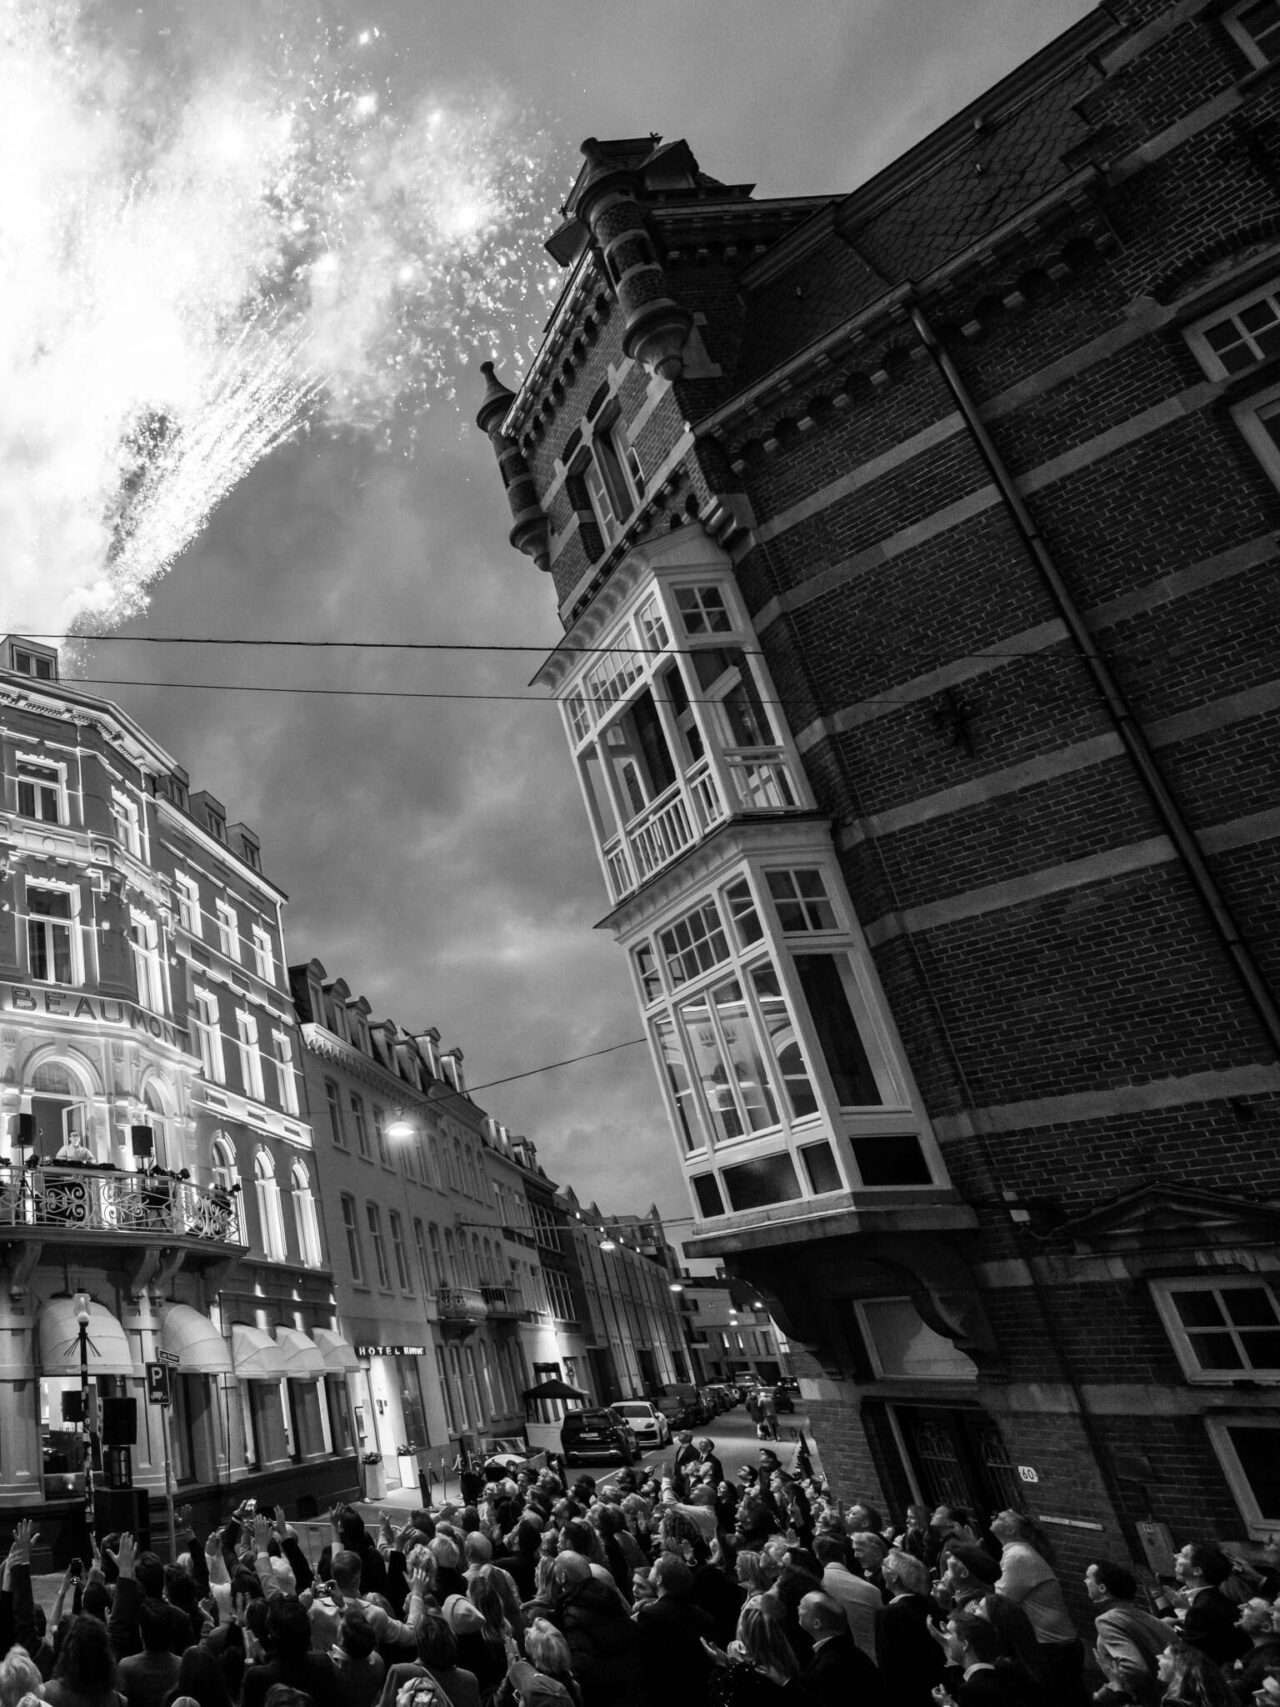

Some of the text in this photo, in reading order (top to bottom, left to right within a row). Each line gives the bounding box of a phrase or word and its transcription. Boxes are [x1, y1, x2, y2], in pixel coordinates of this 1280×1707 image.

[11, 985, 189, 1052] BEAUMONT
[359, 1346, 401, 1355] HOTEL
[151, 1366, 163, 1387] P
[1022, 1468, 1035, 1480] 60
